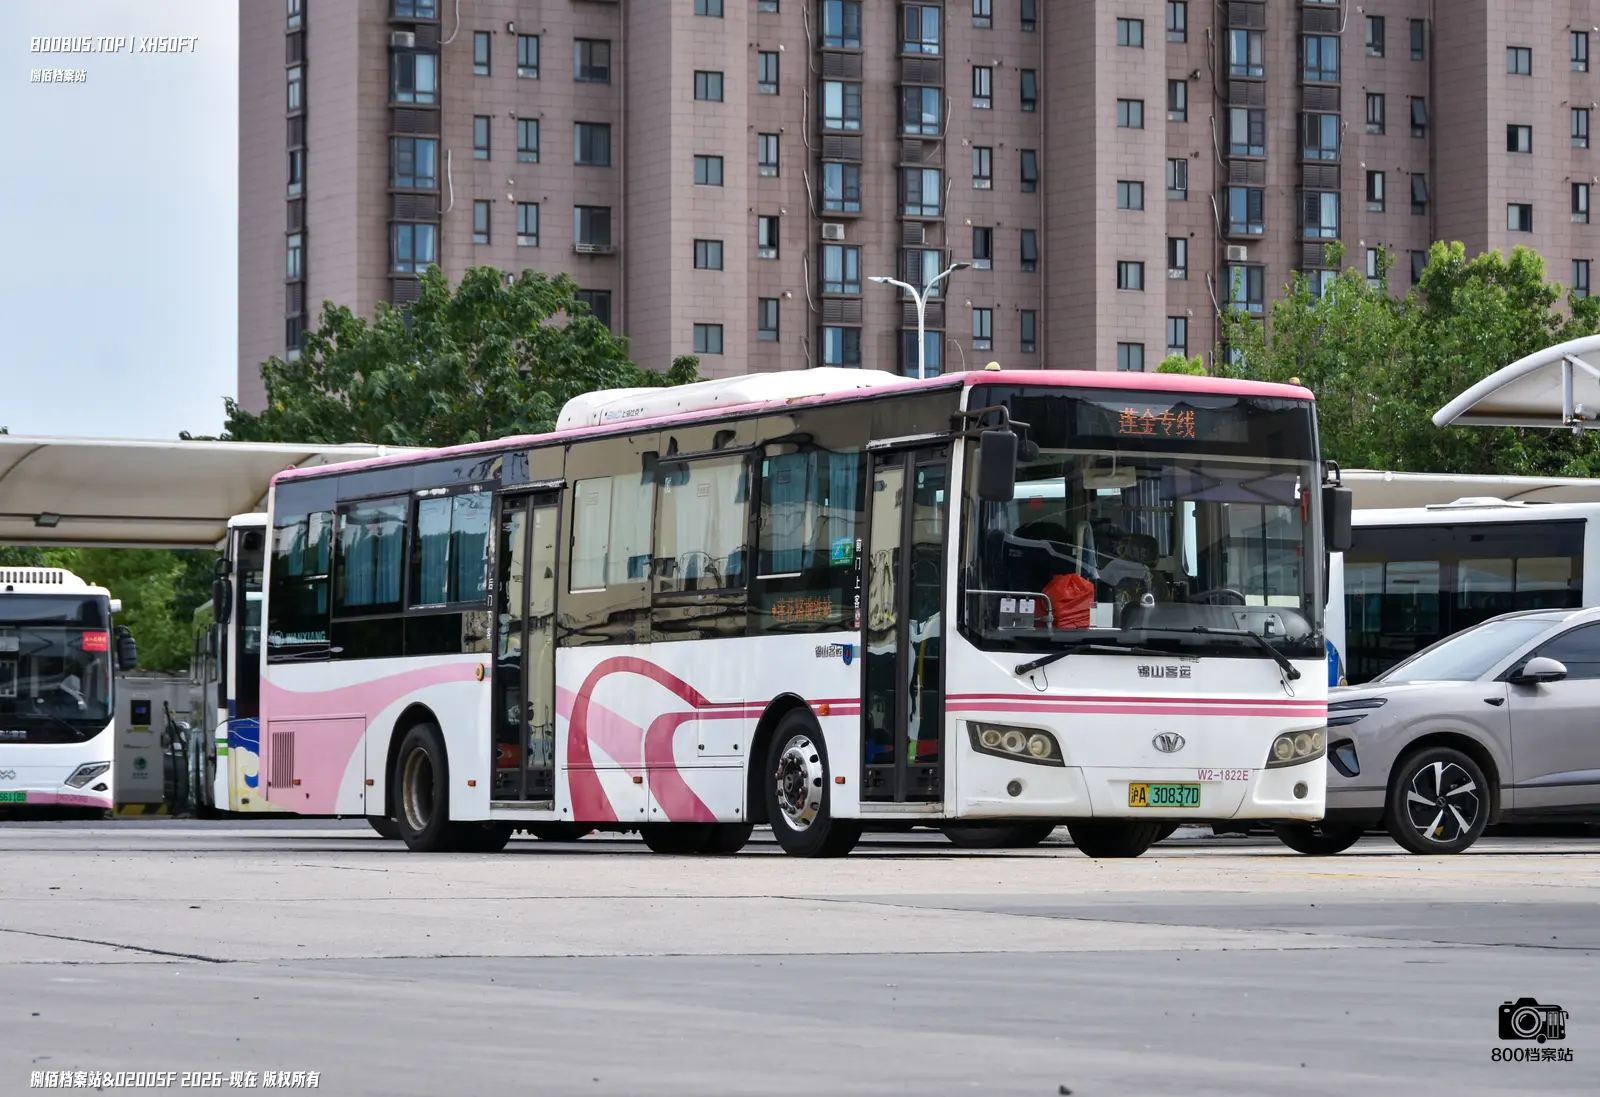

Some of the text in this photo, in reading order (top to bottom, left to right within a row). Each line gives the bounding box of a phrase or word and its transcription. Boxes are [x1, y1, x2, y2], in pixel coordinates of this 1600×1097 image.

[1119, 407, 1196, 438] 莲金专线
[1197, 769, 1249, 781] W2-1822E
